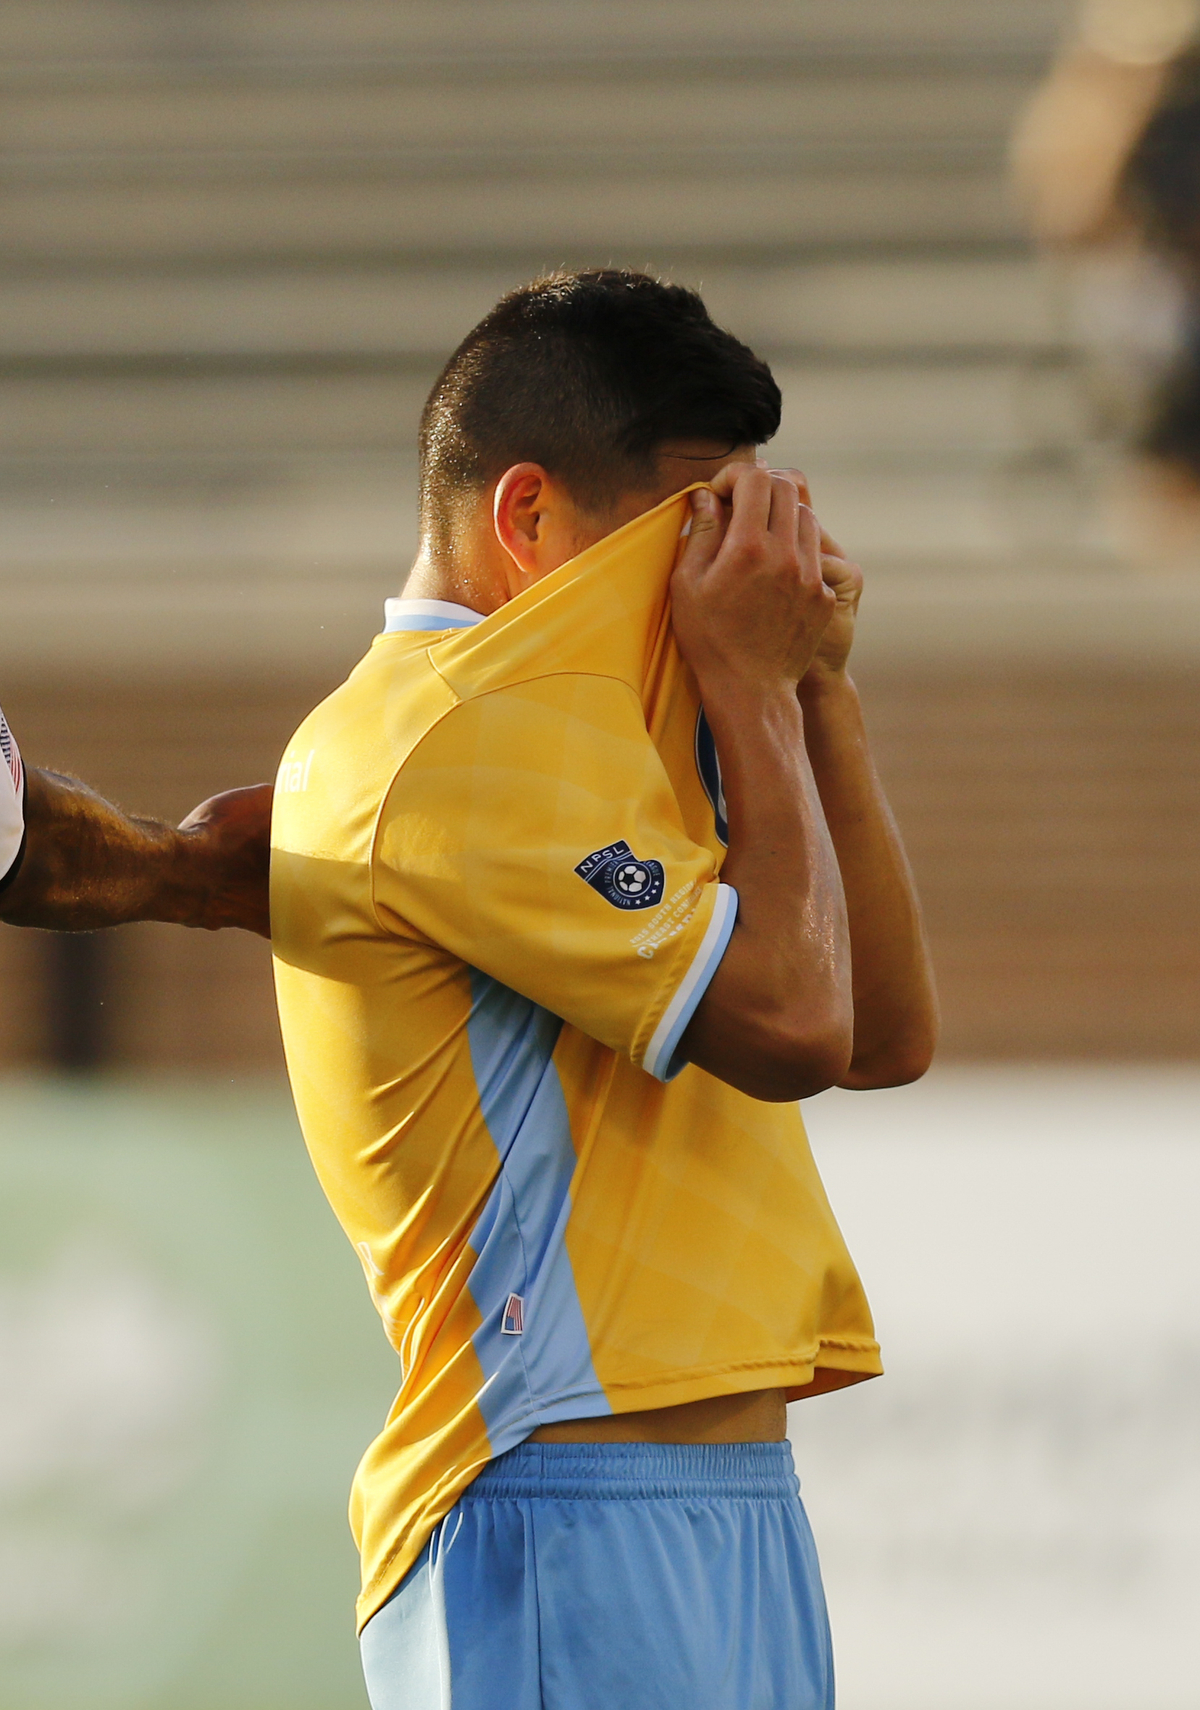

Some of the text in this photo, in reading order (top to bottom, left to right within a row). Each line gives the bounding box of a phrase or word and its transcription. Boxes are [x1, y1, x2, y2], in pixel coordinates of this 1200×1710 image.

[274, 748, 316, 795] rial
[580, 846, 624, 873] NPSL
[647, 903, 672, 929] SOUTH
